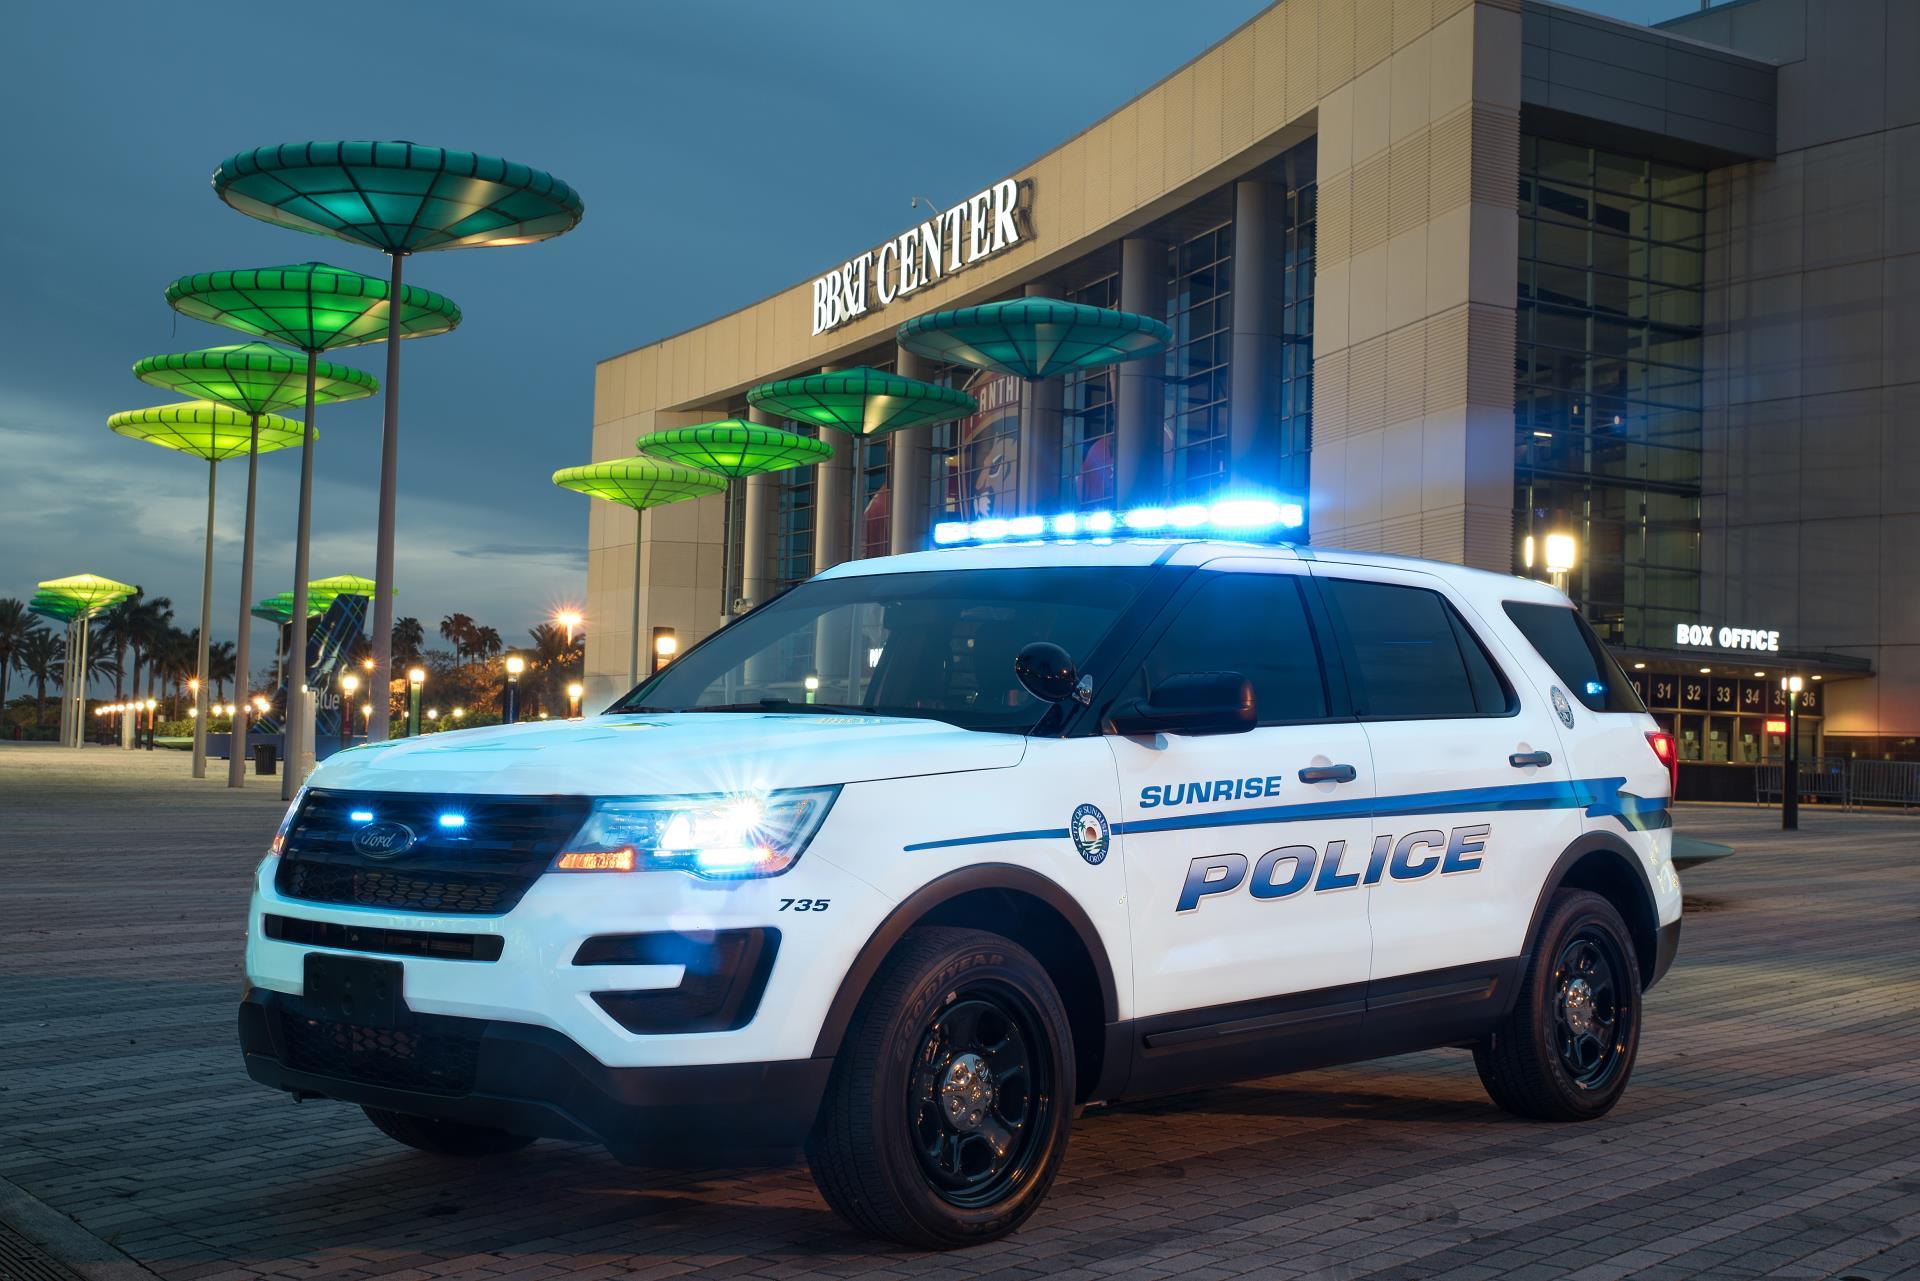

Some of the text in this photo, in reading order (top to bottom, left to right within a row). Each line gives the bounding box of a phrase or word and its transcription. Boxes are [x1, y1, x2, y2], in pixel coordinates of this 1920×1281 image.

[812, 178, 1020, 336] BB&T CENTER
[1676, 623, 1780, 651] BOX OFFICE
[1657, 683, 1672, 699] 31
[1687, 685, 1701, 700] 32
[1716, 686, 1731, 702] 33
[1745, 688, 1759, 704] 34
[1802, 691, 1816, 707] 36
[1139, 775, 1282, 809] SUNRISE
[1072, 819, 1080, 841] CITY
[1083, 805, 1108, 836] SUNRISE
[360, 831, 397, 848] Ford
[1082, 848, 1107, 864] FLORIDA
[1175, 823, 1492, 914] POLICE
[778, 898, 831, 912] 735
